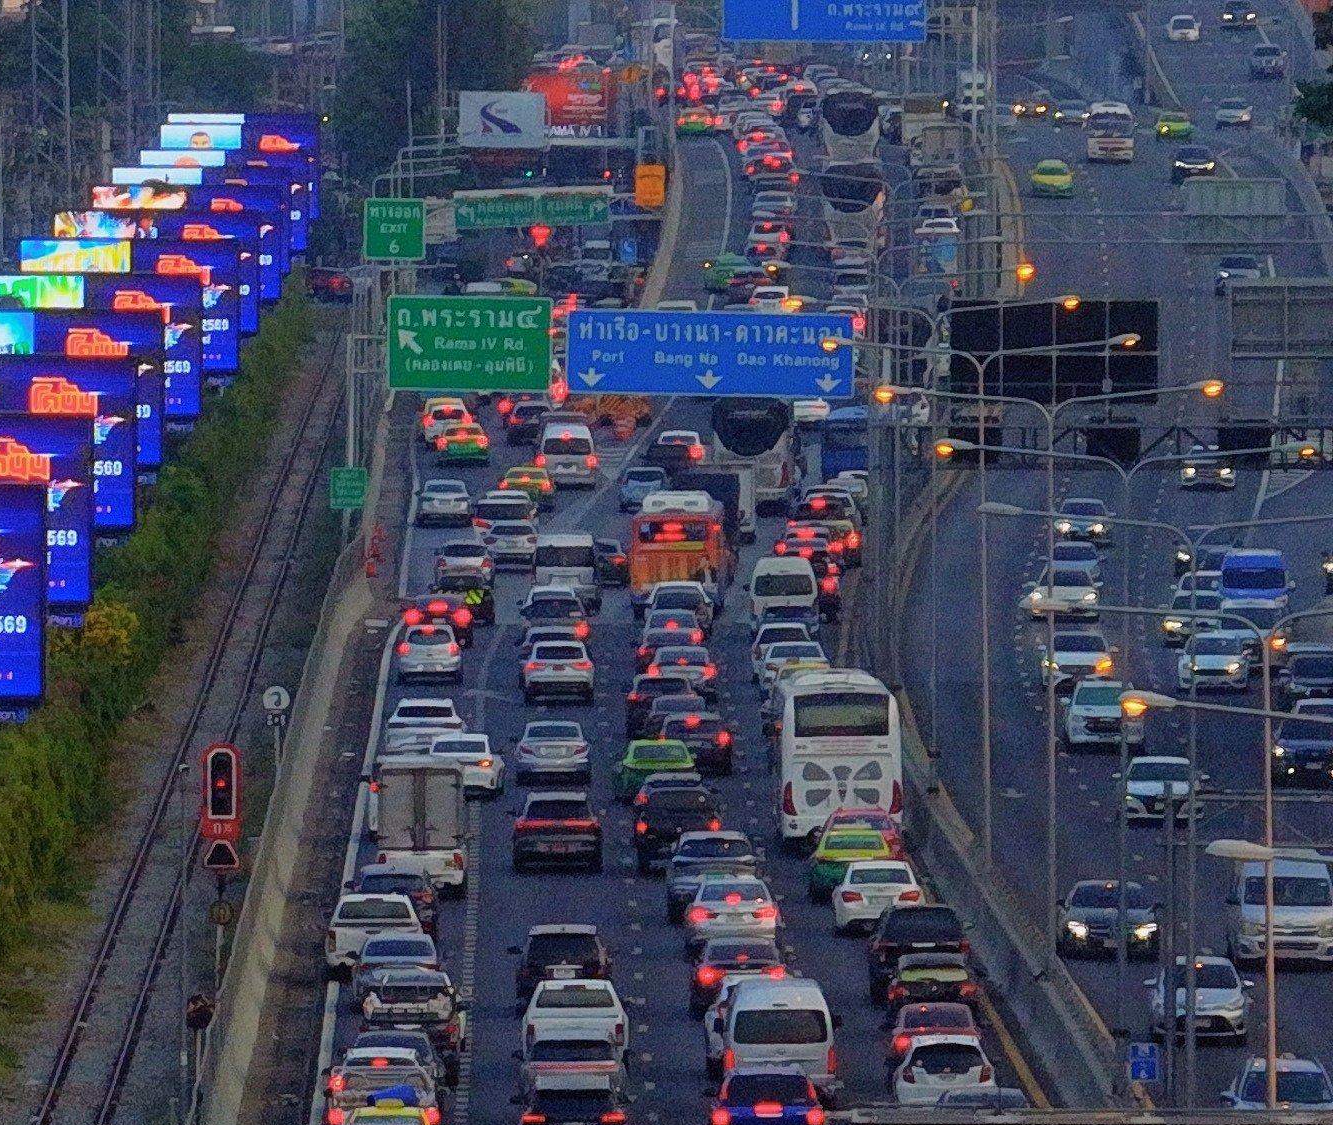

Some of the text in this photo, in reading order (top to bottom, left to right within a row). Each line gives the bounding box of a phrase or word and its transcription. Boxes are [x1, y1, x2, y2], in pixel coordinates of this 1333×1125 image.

[370, 205, 421, 219] ทางออก
[380, 223, 408, 234] EXIT
[389, 240, 400, 254] 6
[434, 337, 477, 350] Rama
[592, 349, 625, 364] Port
[654, 351, 694, 367] Bang
[773, 352, 840, 371] Khanong
[46, 530, 78, 546] 569
